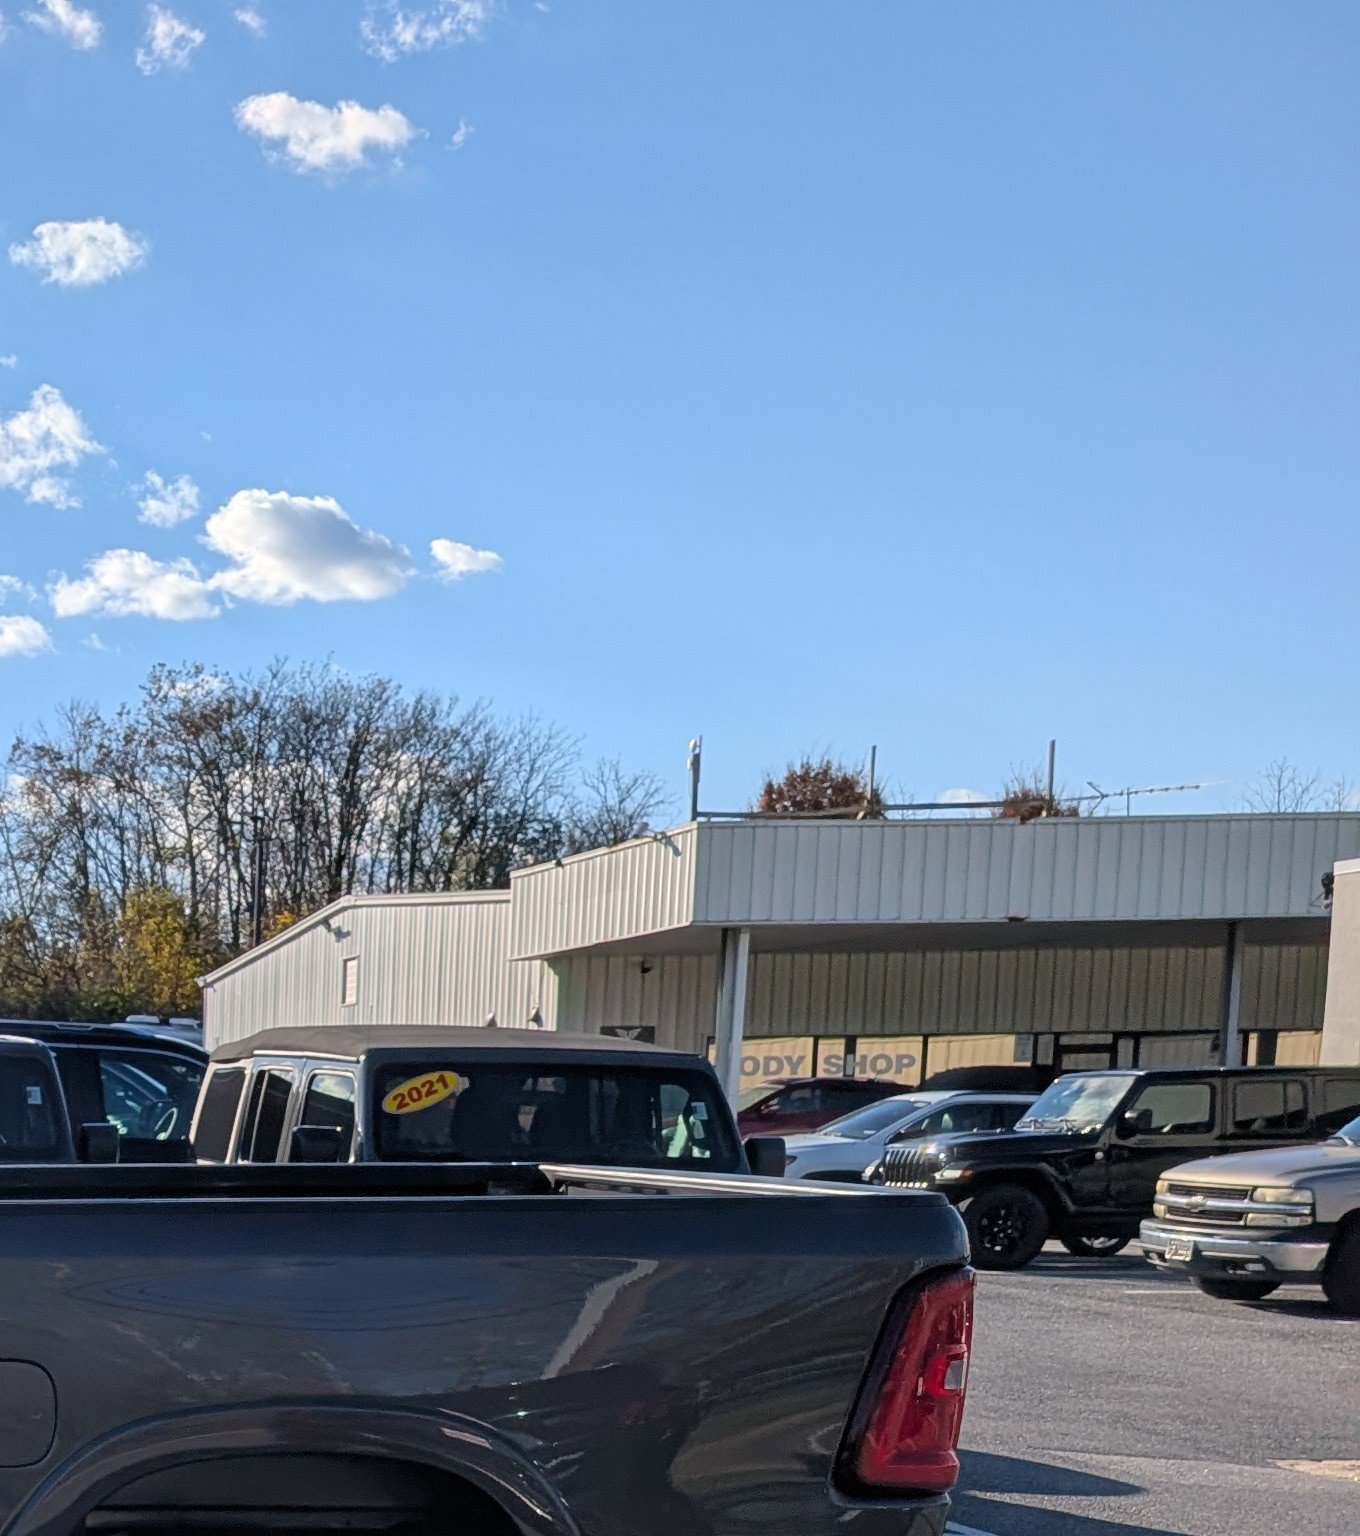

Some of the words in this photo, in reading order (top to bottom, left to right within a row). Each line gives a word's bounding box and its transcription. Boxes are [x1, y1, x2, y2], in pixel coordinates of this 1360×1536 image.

[740, 1054, 806, 1077] ODY
[822, 1053, 916, 1075] SHOP
[392, 1073, 449, 1111] 2021
